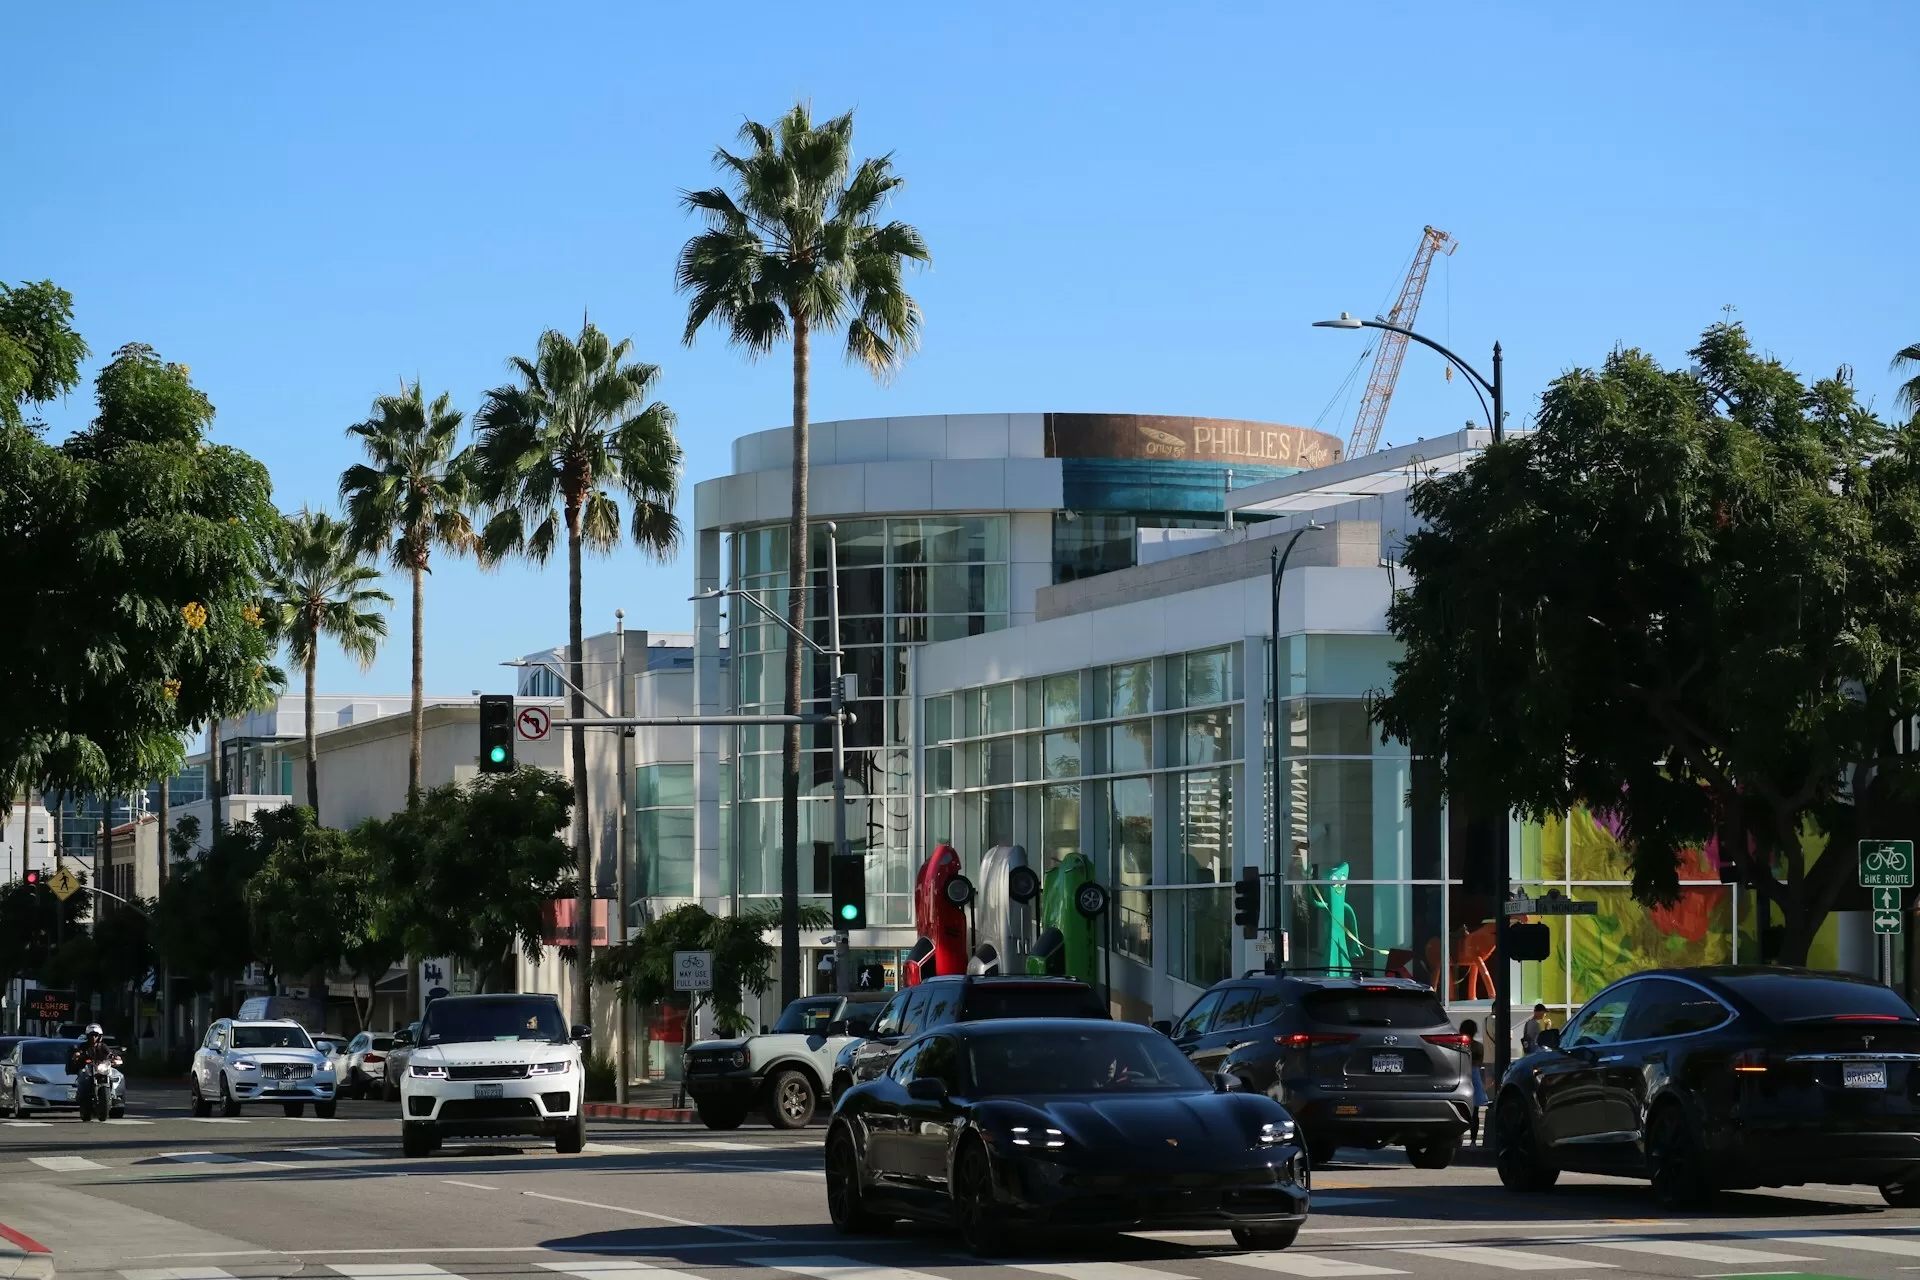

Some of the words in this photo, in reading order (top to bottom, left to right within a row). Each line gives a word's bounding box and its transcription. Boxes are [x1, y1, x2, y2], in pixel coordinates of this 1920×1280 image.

[1194, 427, 1290, 460] PHILLIES
[1864, 874, 1881, 884] BIKE
[1885, 874, 1909, 884] ROUTE
[1505, 901, 1520, 913] BEVERLY
[1551, 903, 1583, 913] MONICA
[679, 970, 692, 978] MAY
[695, 970, 708, 978] USE
[676, 979, 692, 987] FULL
[694, 979, 710, 987] LANE
[31, 1002, 69, 1011] WILSHIRE
[1846, 1071, 1883, 1083] 8RXH552
